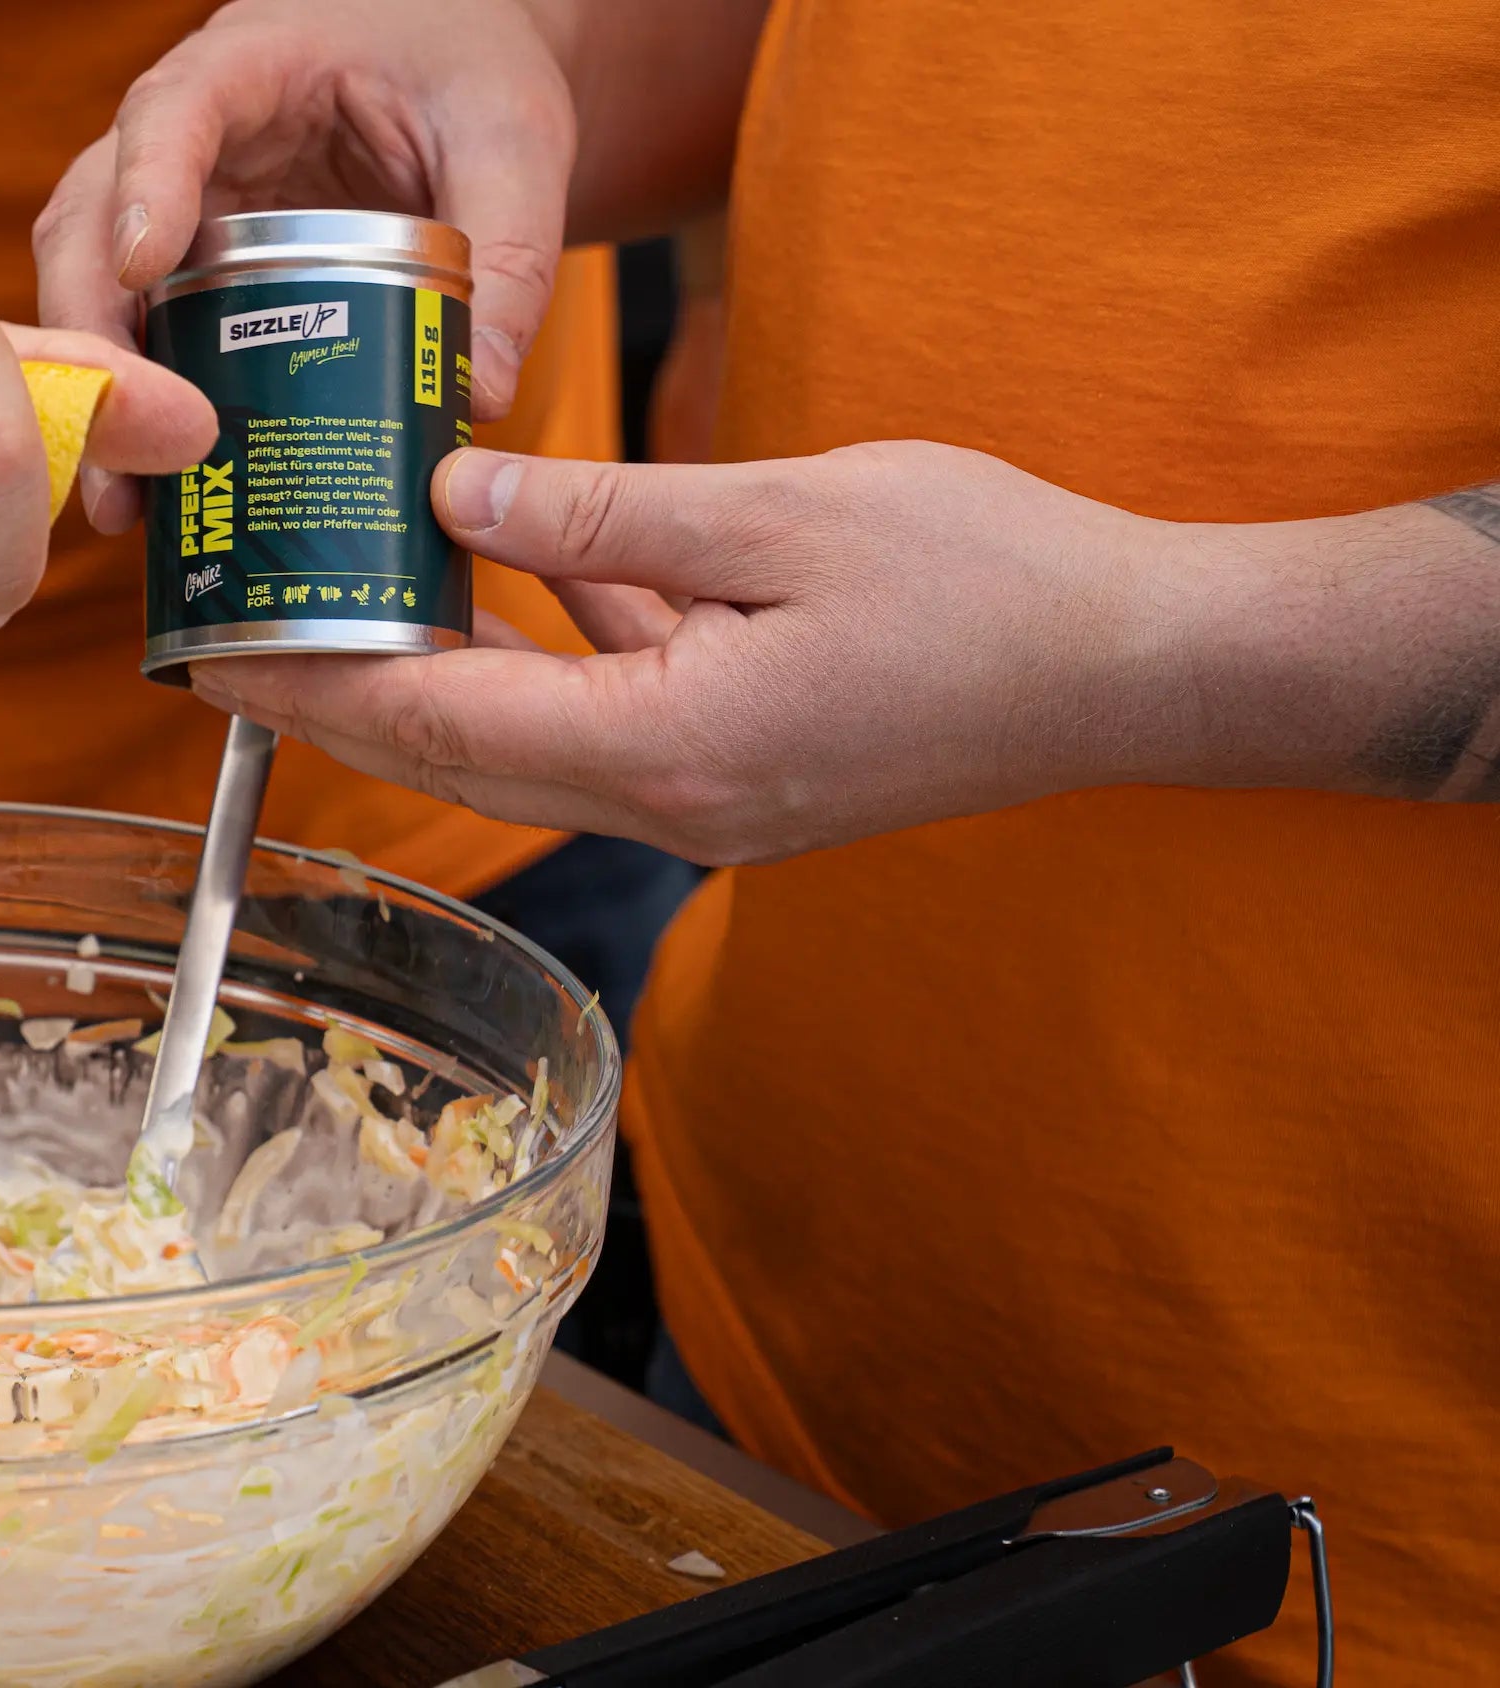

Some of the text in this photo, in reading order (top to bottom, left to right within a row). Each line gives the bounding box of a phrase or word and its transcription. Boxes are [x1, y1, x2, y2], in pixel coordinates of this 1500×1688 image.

[421, 325, 439, 395] 115 g
[248, 416, 403, 430] Unsere Top-Three unter allen
[248, 431, 323, 443] Pfeffersorten
[325, 432, 344, 441] der
[346, 432, 371, 442] Welt
[381, 434, 394, 444] so
[248, 446, 392, 459] pfiffig abgestimmt wie die
[248, 460, 374, 473] Playlist fürs erste Date.
[248, 475, 394, 490] Haben wir jetzt echt pfiffig
[248, 490, 387, 504] gesagt? Genug der Worte.
[202, 460, 234, 553] MIX
[248, 505, 400, 518] Gehen wir zu dir, zu mir oder
[248, 519, 407, 533] dahin, wo der Pfeffer wächst?
[247, 583, 271, 596] USE
[247, 595, 274, 608] FOR:
